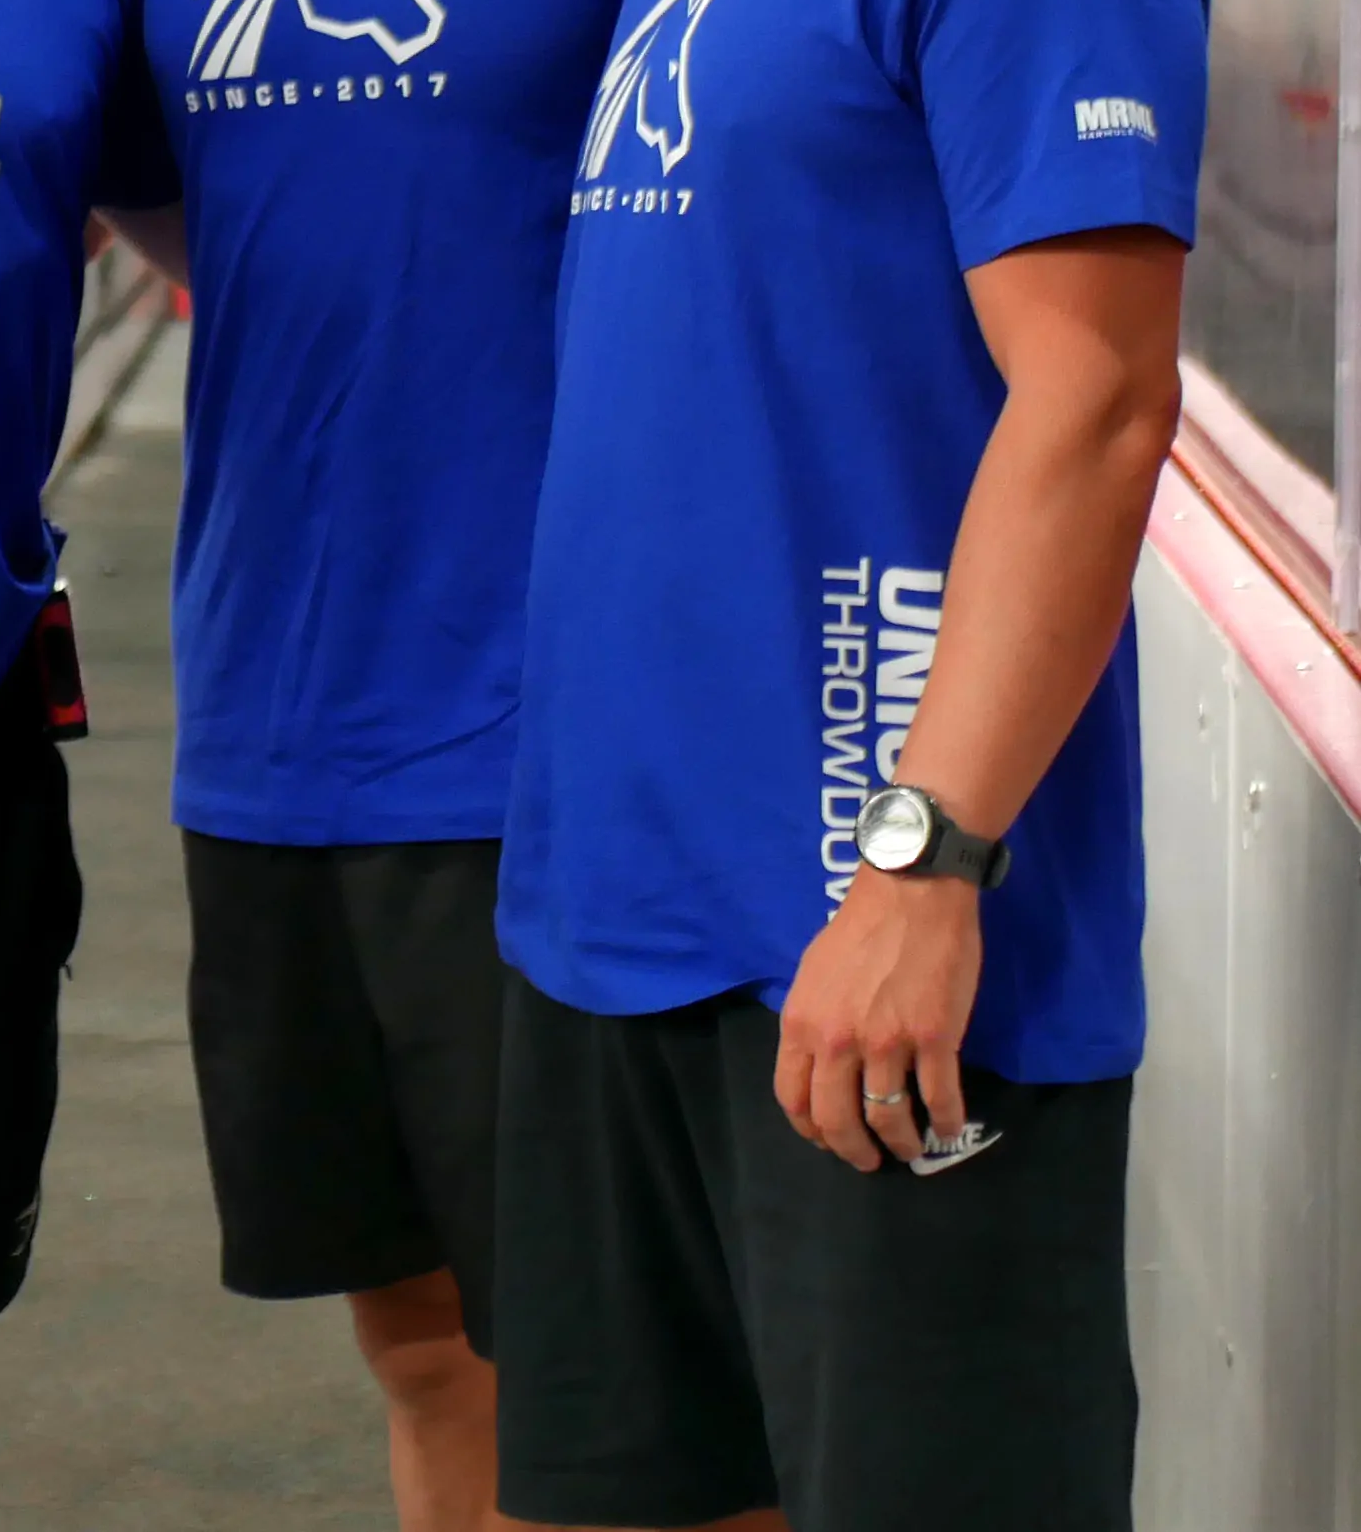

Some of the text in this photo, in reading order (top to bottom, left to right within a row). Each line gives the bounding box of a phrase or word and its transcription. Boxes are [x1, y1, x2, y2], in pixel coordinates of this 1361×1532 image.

[185, 71, 448, 114] SINCE 2017
[632, 187, 693, 216] 2017
[821, 557, 871, 926] THROWDO
